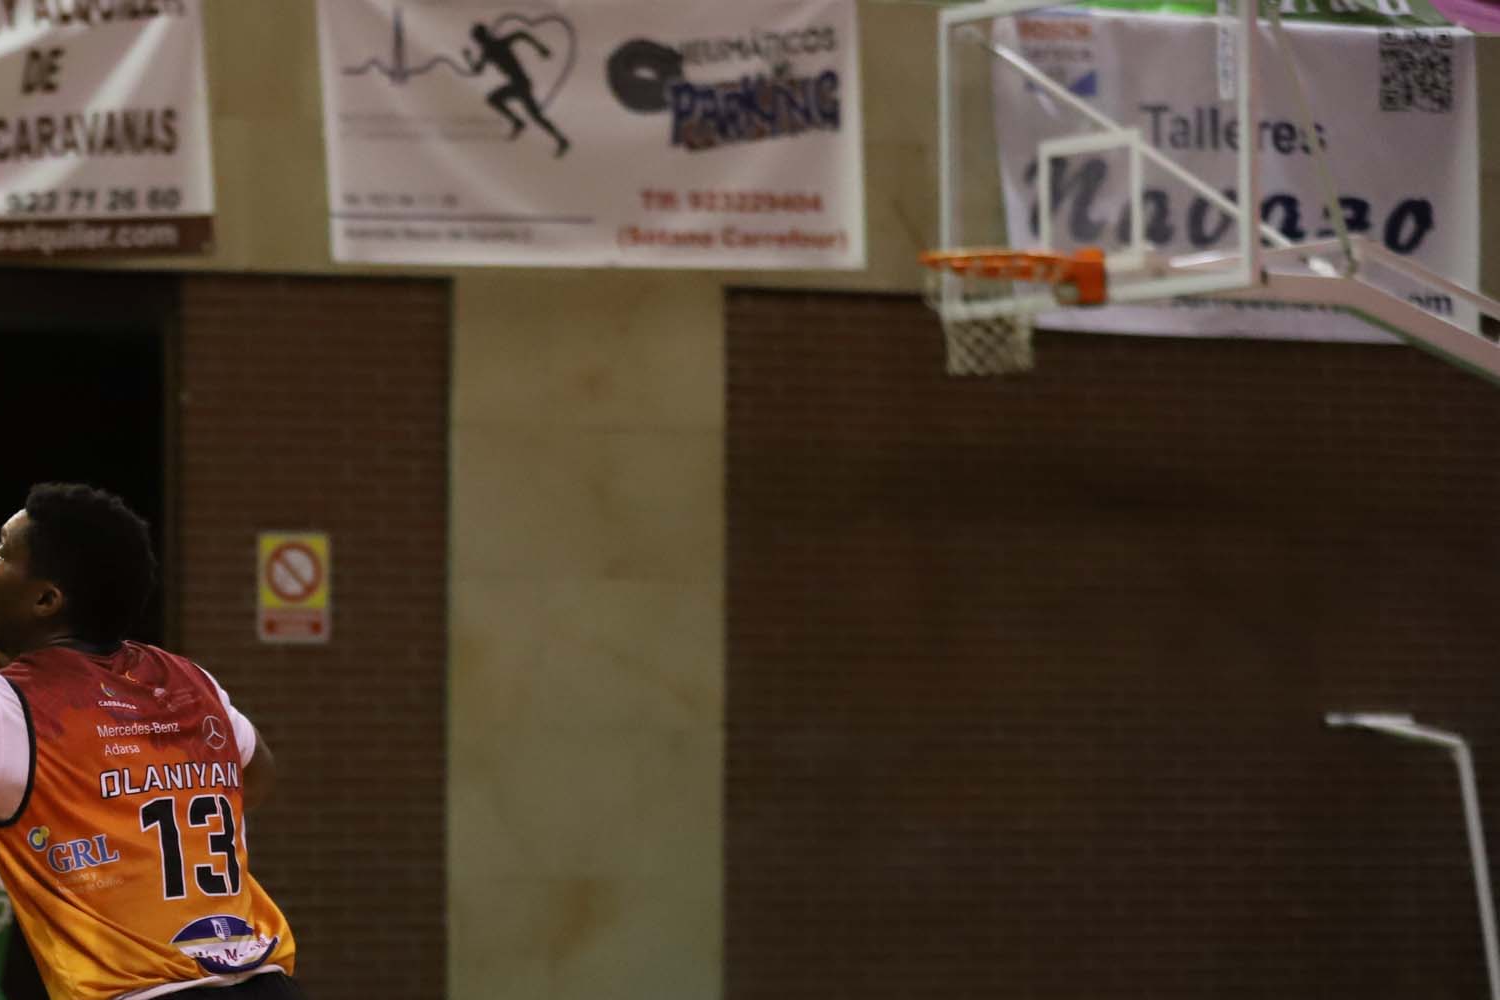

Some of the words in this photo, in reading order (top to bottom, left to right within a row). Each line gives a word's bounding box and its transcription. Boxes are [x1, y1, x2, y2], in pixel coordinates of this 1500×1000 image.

[20, 48, 67, 95] DE
[97, 721, 181, 739] Mercedes-Benz
[104, 743, 141, 758] Adarsa
[100, 761, 239, 799] OLANIYAN
[47, 833, 120, 874] GRL
[139, 794, 241, 901] 13
